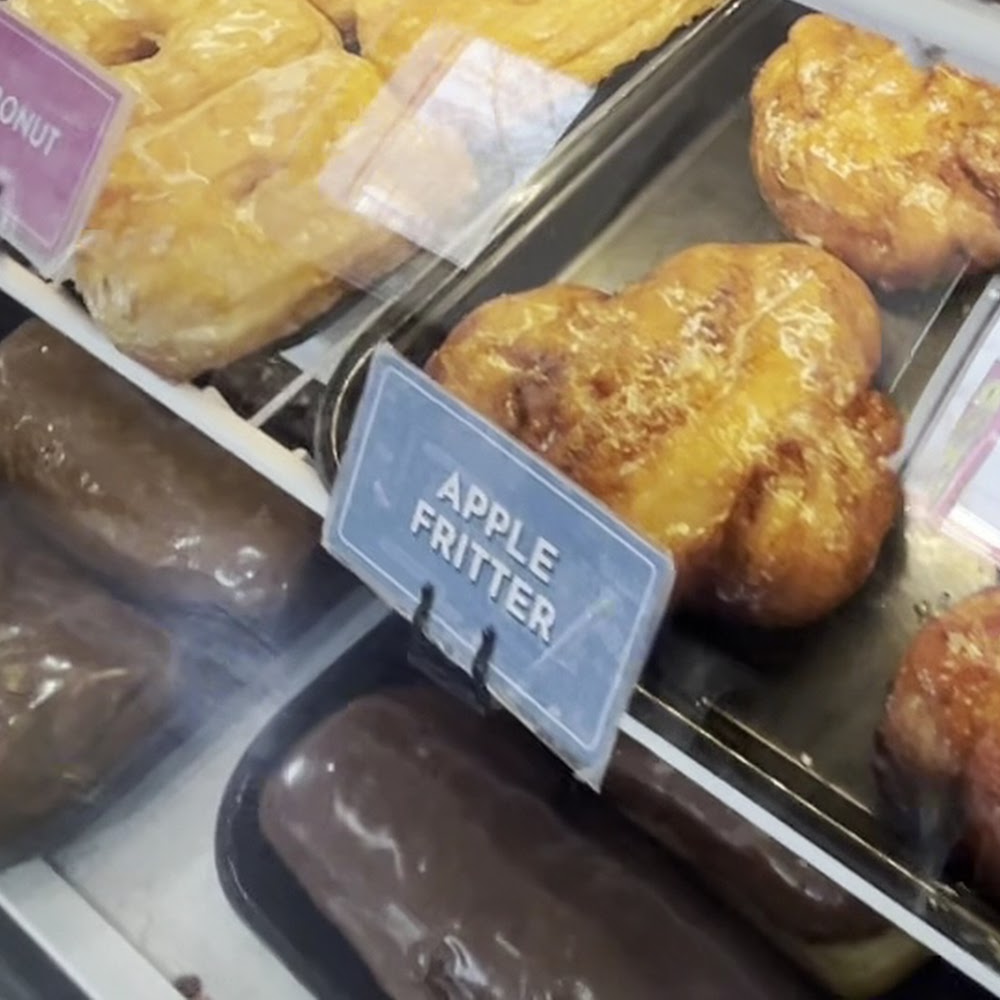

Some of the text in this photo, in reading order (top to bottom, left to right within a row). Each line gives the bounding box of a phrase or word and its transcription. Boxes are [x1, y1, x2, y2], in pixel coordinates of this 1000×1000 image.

[0, 86, 61, 157] ONUT
[410, 500, 556, 643] FRITTER
[435, 471, 560, 584] APPLE
